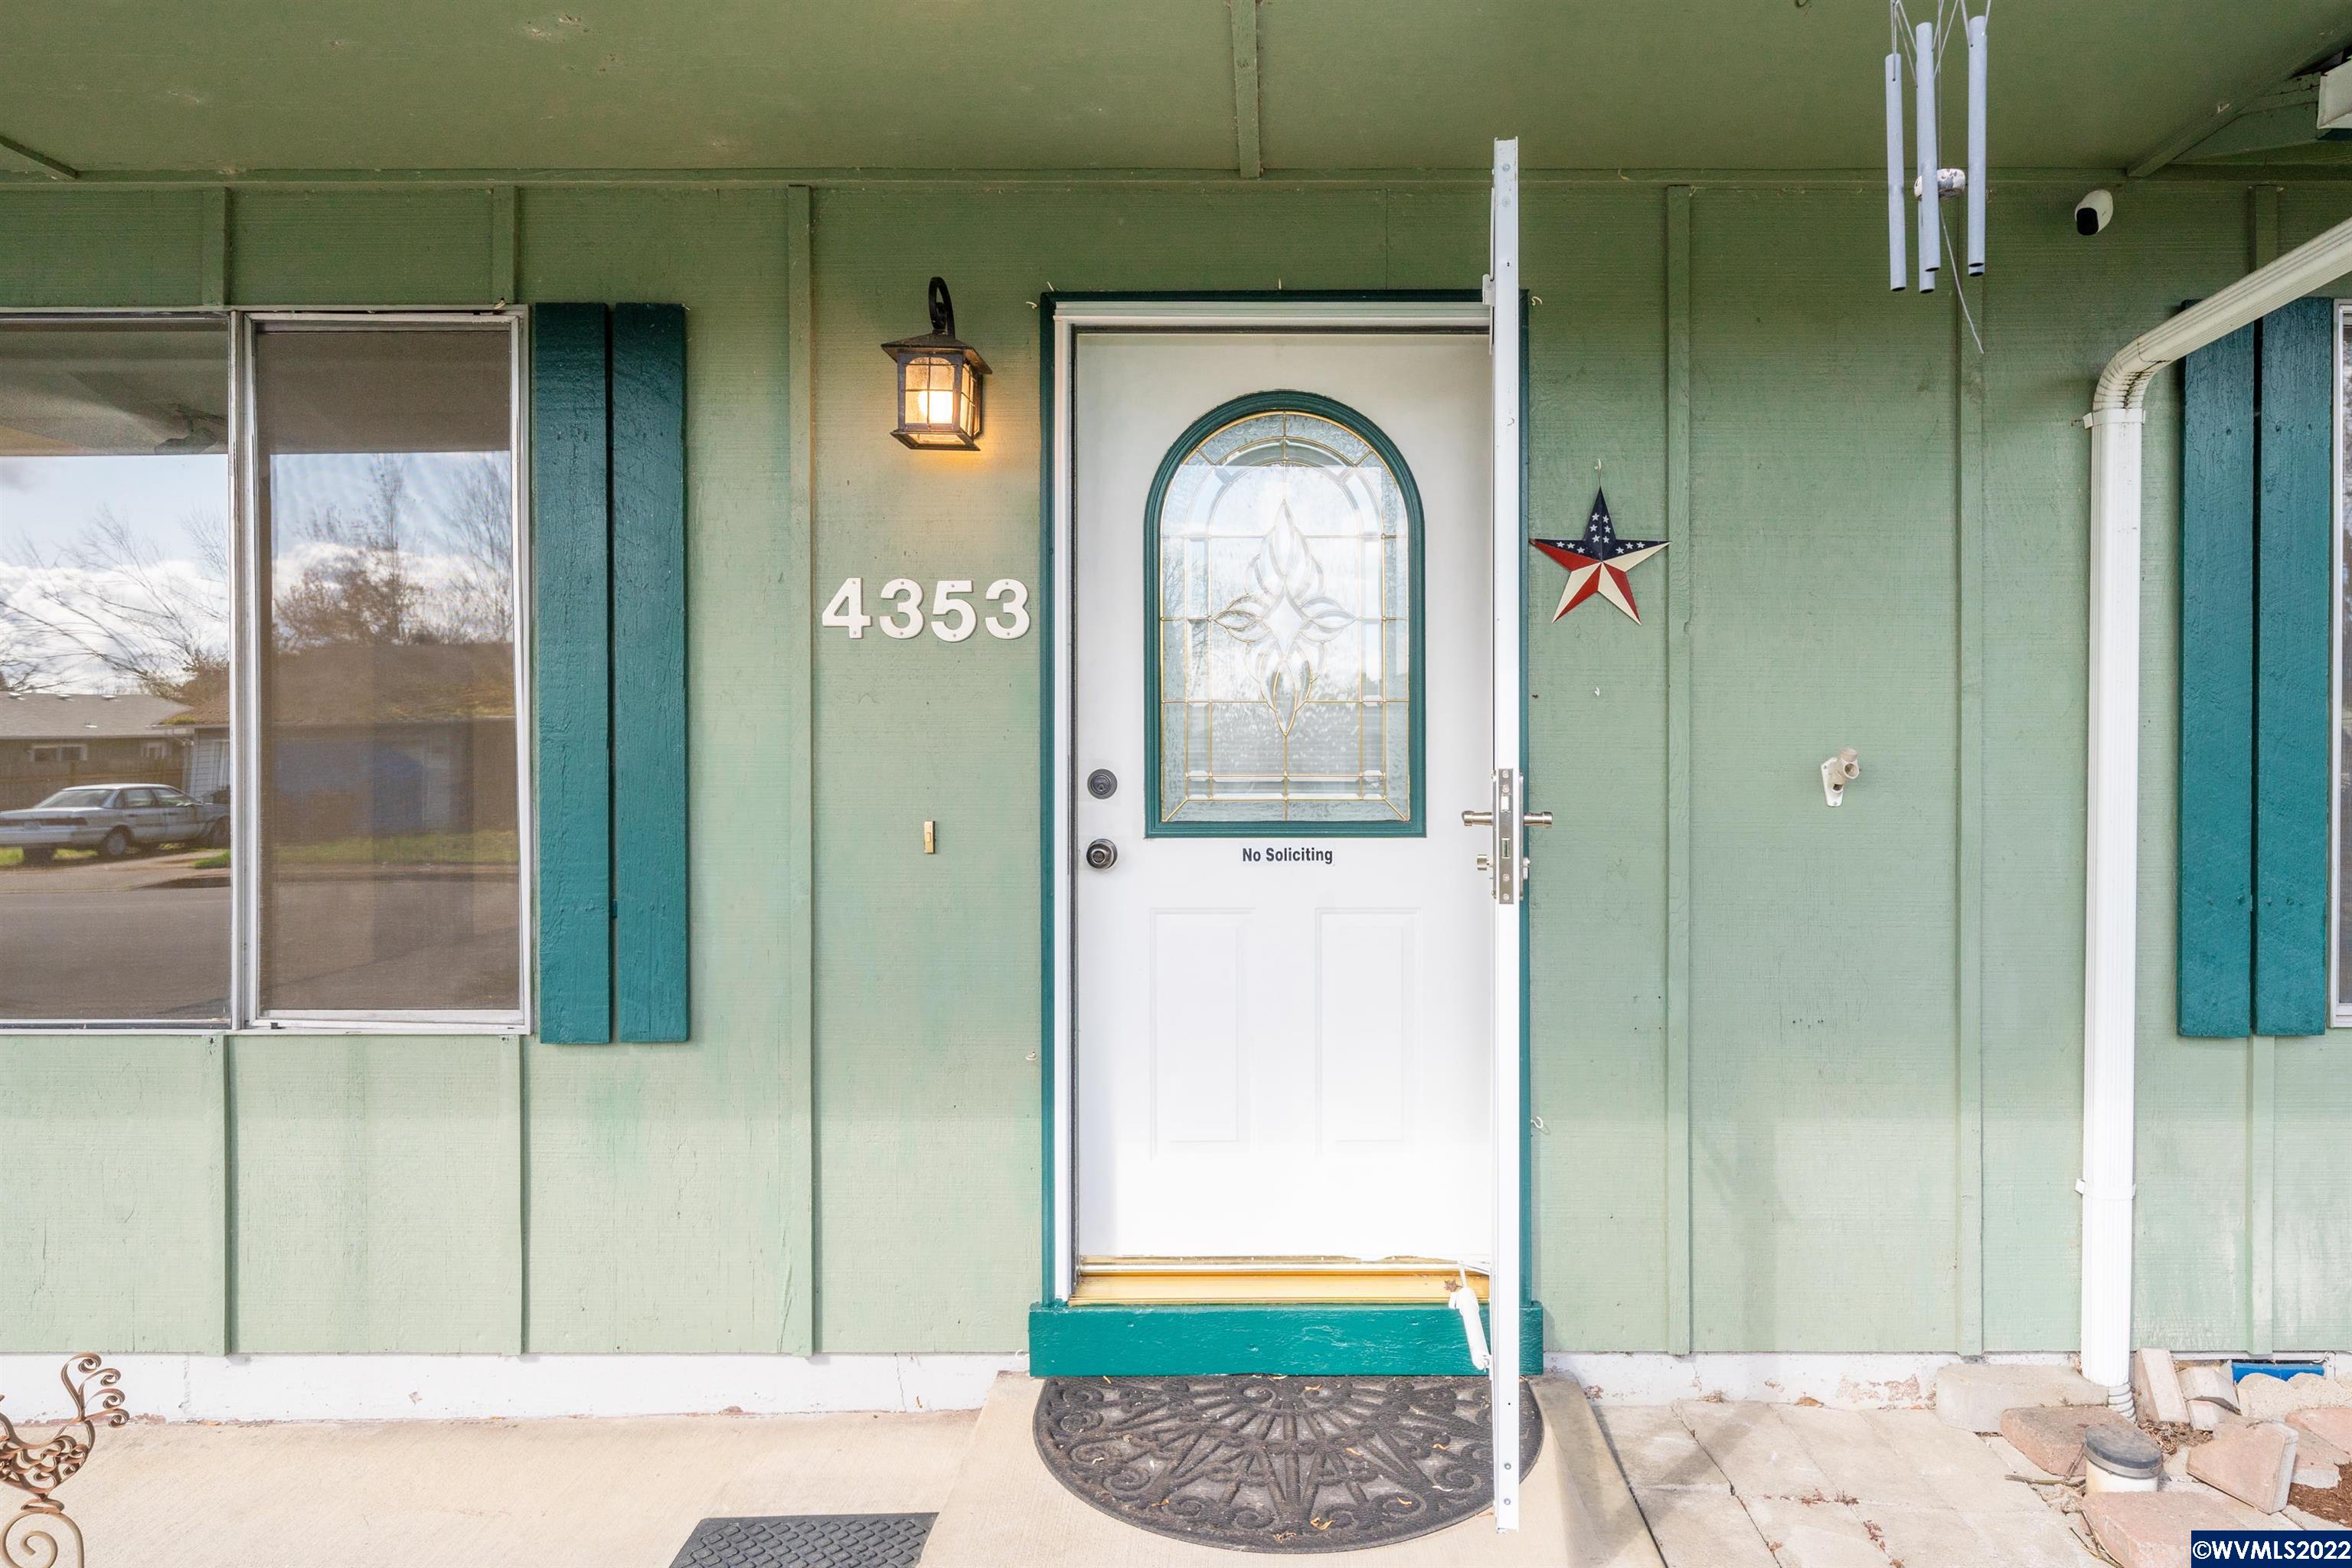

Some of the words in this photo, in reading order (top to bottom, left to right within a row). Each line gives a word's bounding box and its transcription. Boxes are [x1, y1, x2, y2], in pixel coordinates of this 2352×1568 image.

[822, 577, 1031, 642] 4353
[1242, 848, 1261, 862] No
[1266, 847, 1334, 864] Soliciting
